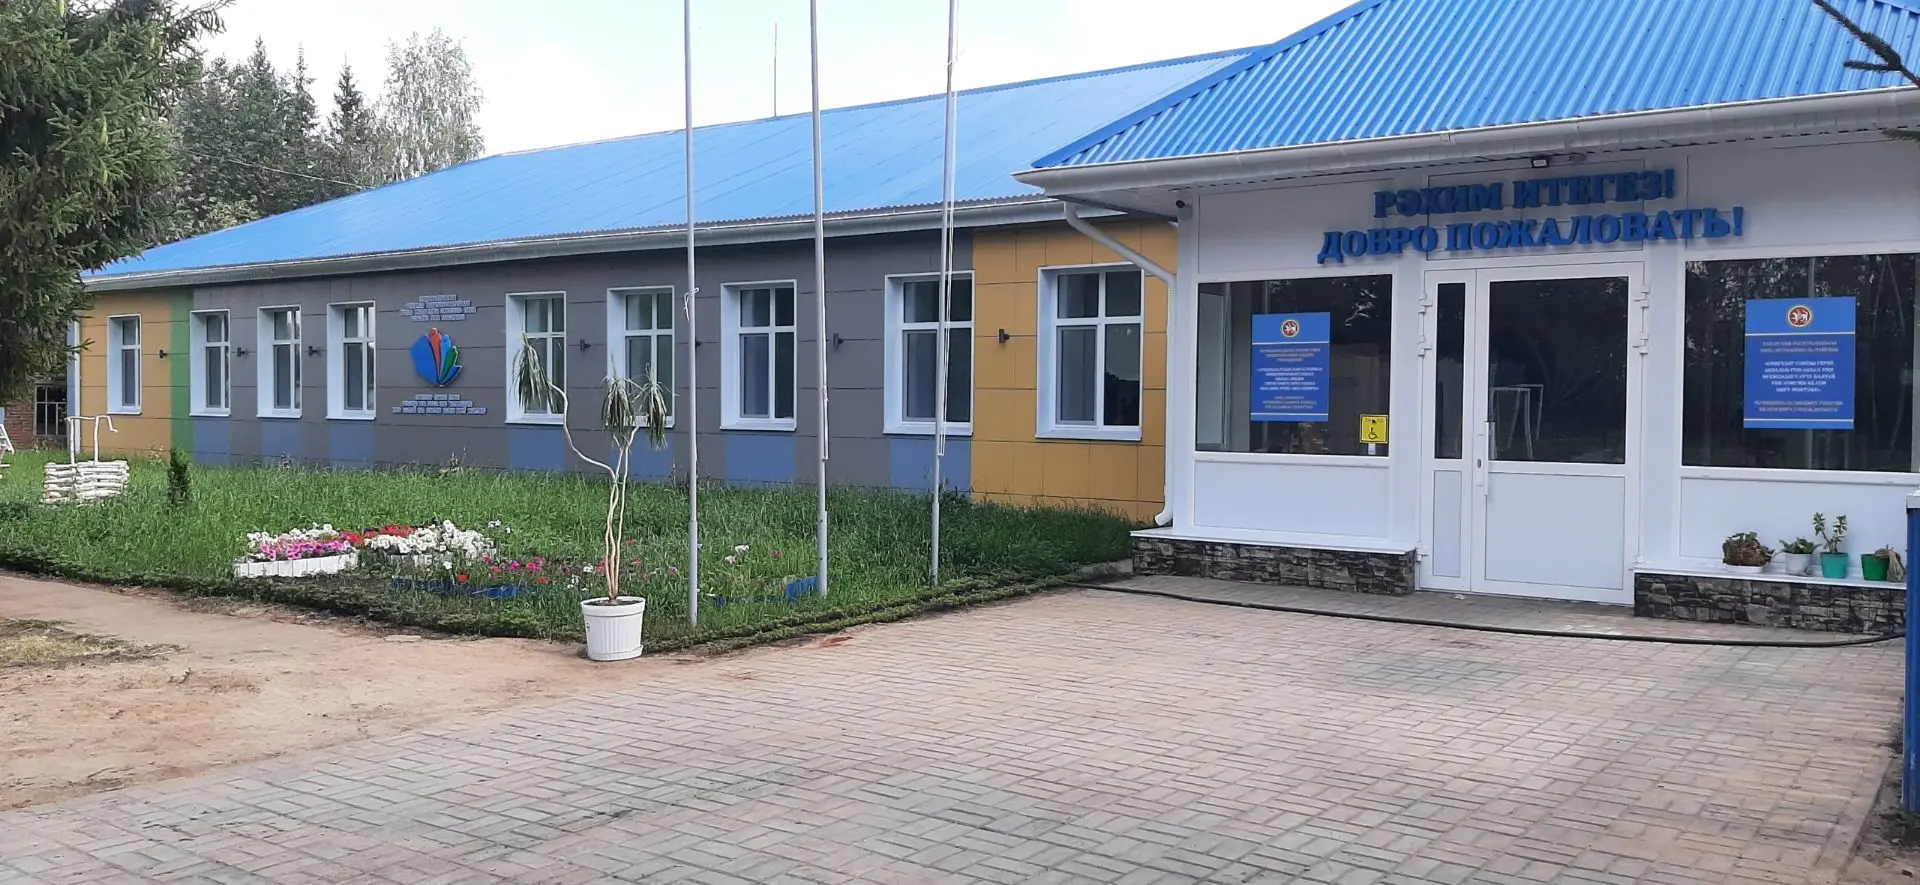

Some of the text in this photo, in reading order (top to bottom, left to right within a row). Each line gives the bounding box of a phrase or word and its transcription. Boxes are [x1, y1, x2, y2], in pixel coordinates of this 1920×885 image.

[1373, 168, 1676, 218] РӘХИМ ИТЕГЕЗ!
[1317, 206, 1744, 265] ДОБРО ПОЖАЛОВАТЬ!
